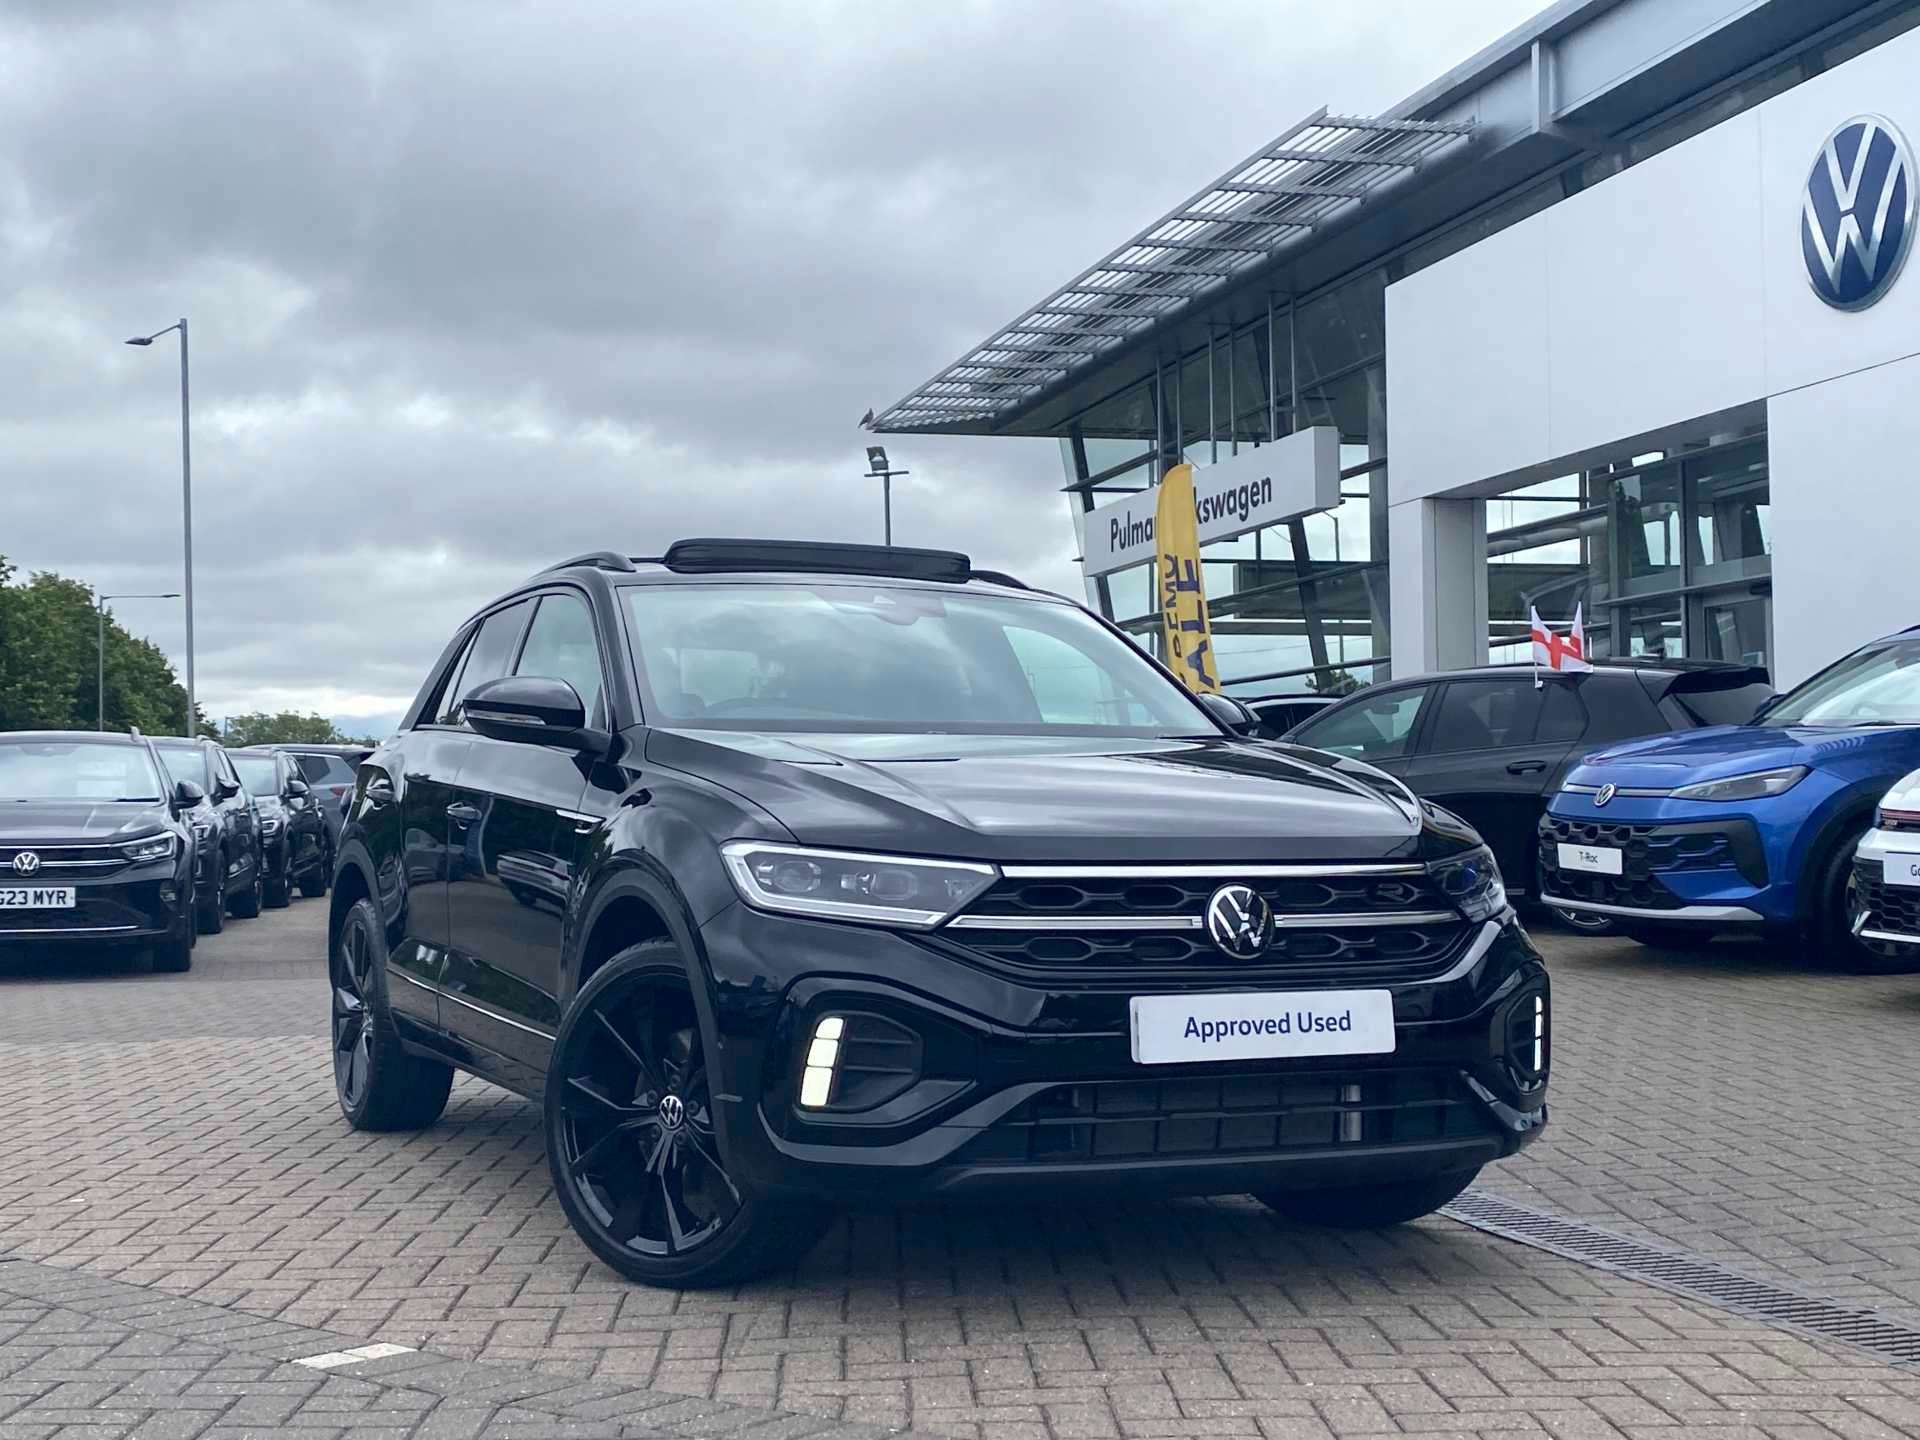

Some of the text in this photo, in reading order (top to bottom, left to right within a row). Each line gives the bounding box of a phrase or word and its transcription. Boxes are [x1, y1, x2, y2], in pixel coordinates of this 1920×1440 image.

[1110, 476, 1272, 552] Pulma kswagen
[1175, 556, 1216, 694] ALE
[33, 890, 67, 905] MYR
[1184, 1010, 1351, 1042] Approved Used
